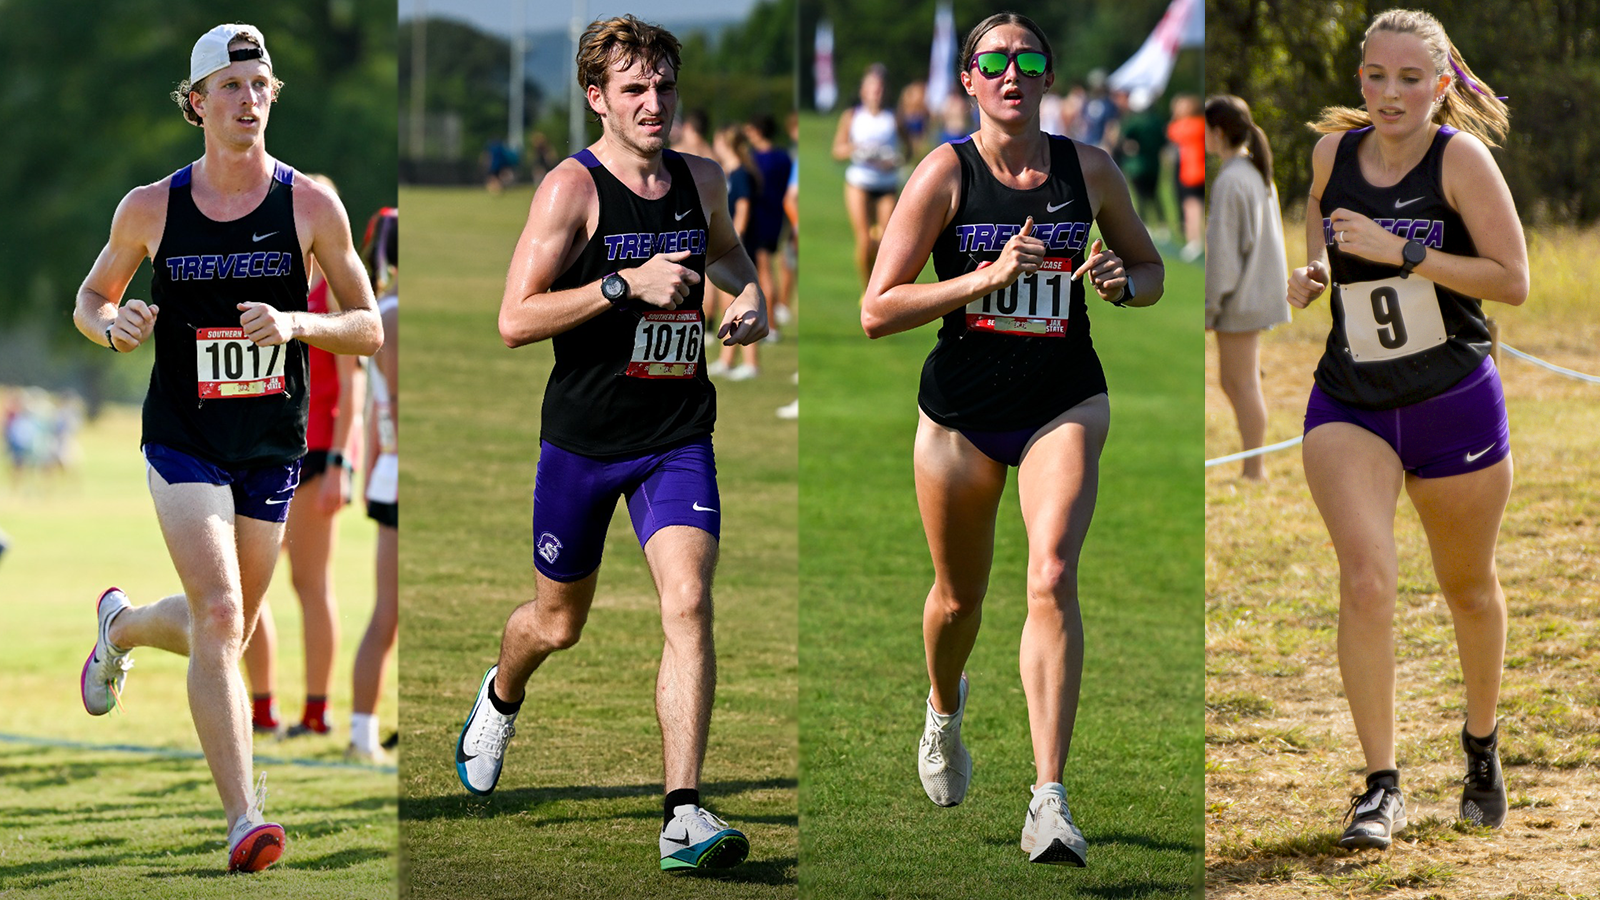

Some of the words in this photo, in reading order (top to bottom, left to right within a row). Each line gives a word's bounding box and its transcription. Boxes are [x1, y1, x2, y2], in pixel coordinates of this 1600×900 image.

[604, 229, 706, 261] TREVECCA
[1322, 217, 1444, 249] TECCA
[166, 252, 292, 281] TREVECCA
[207, 330, 243, 338] SOUTHERN
[1046, 325, 1064, 333] STATE
[1370, 286, 1408, 350] 9
[642, 324, 700, 362] 1016
[205, 341, 281, 380] 1017
